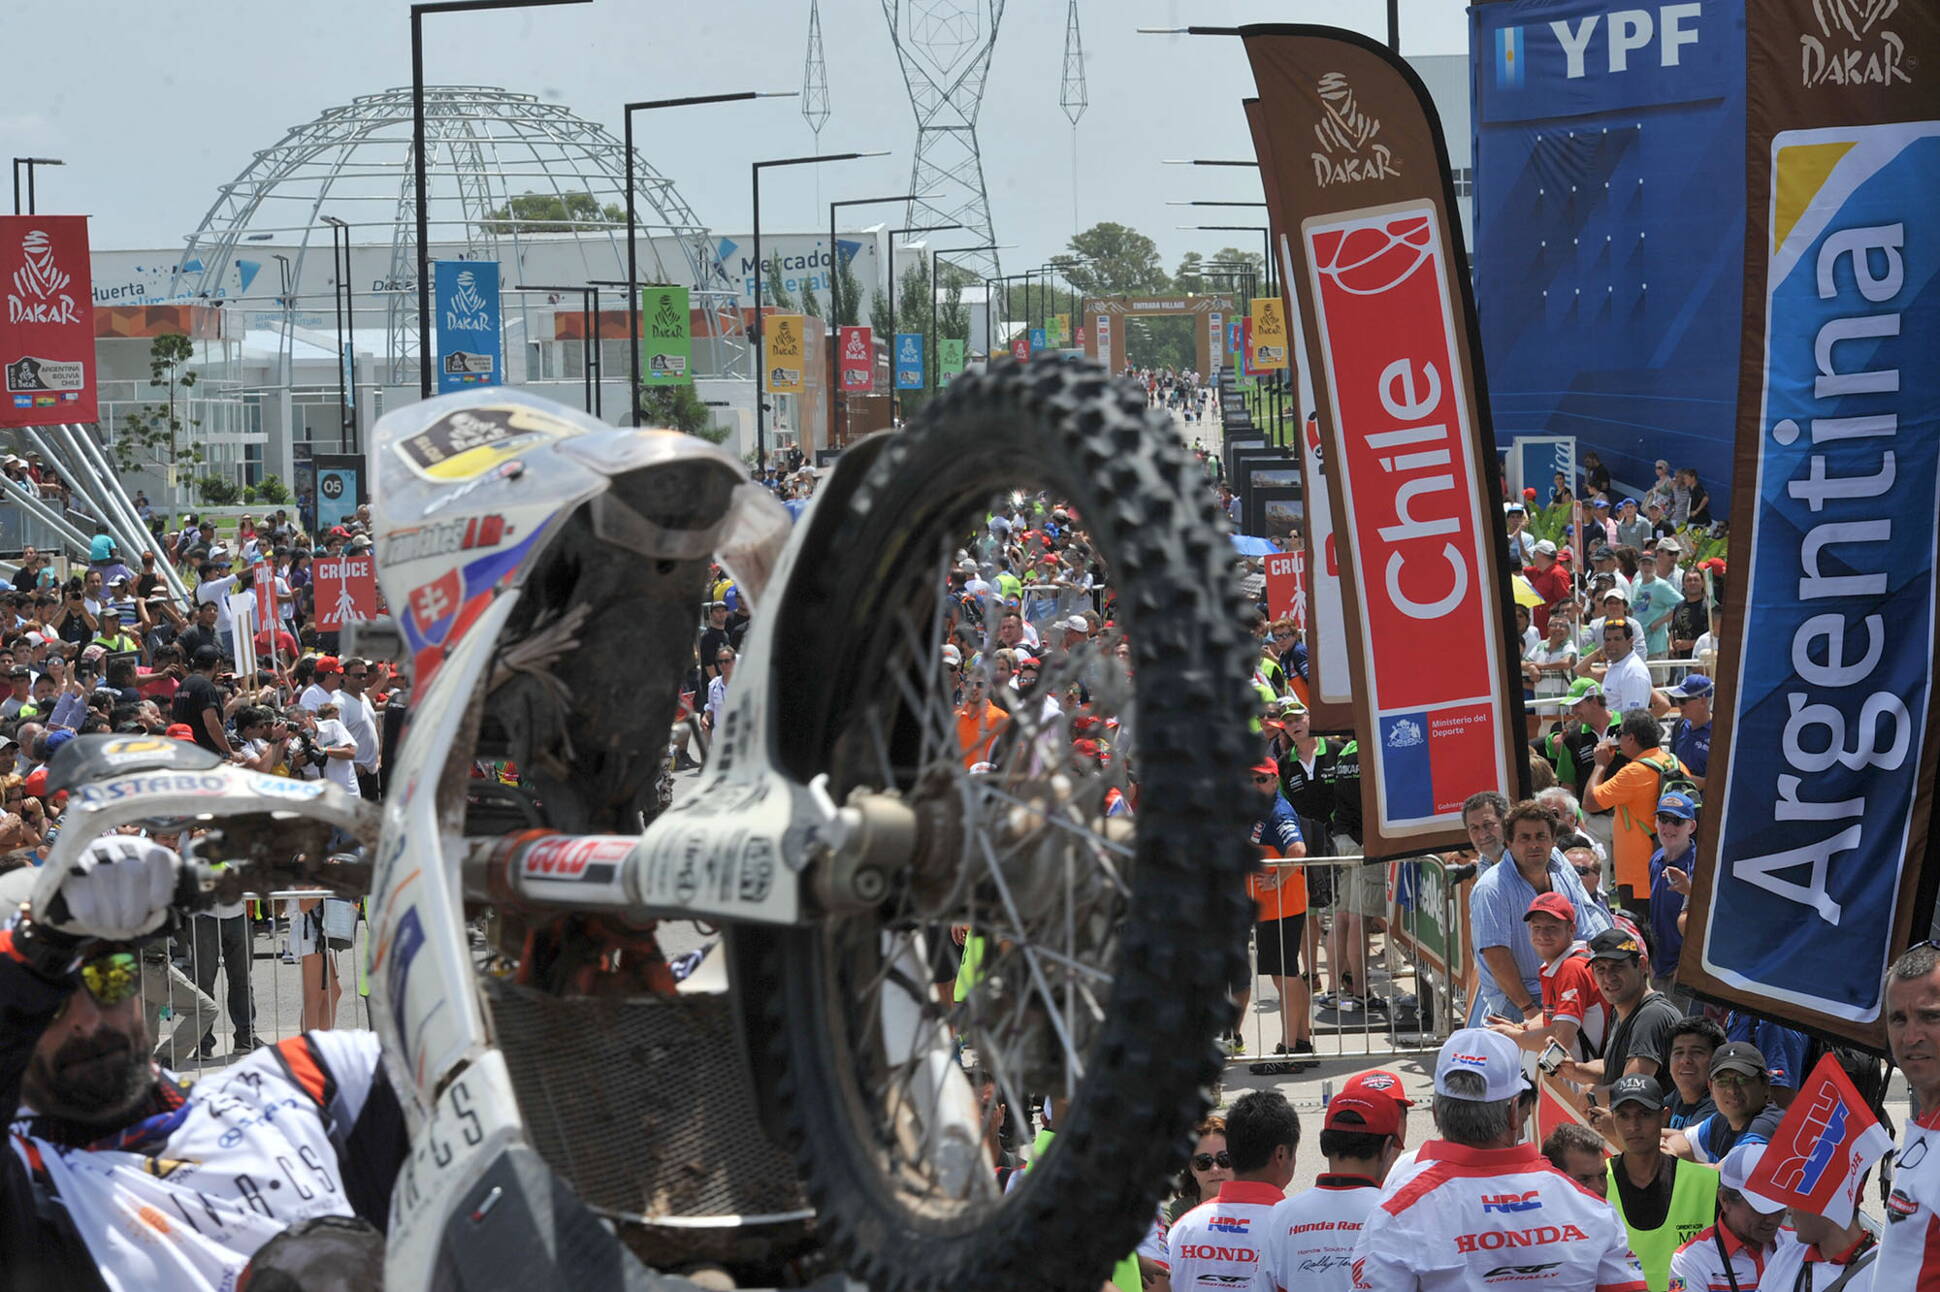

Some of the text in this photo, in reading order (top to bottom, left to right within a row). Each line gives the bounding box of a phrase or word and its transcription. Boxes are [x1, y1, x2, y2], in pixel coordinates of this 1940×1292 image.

[1549, 2, 1700, 79] YPF
[1800, 31, 1912, 88] DAKAR
[1311, 144, 1400, 188] DAKAR
[7, 293, 80, 325] DAKAR
[446, 311, 491, 331] DAKAR
[1257, 324, 1281, 335] DAKAR
[652, 324, 685, 339] DAKAR
[772, 344, 799, 357] DAKAR
[41, 366, 80, 374] ARGENTINA
[323, 479, 342, 494] 05
[1363, 357, 1468, 620] Chile
[319, 562, 369, 580] CRUCE
[1733, 222, 1912, 927] Argentina
[1432, 714, 1487, 728] Ministerio del
[1432, 727, 1465, 738] Deporte
[526, 841, 599, 875] GOLD
[1620, 1078, 1647, 1090] MM
[1481, 1190, 1542, 1214] HRC
[1208, 1216, 1250, 1234] HRC
[1289, 1222, 1334, 1236] Honda
[1453, 1223, 1590, 1255] HONDA
